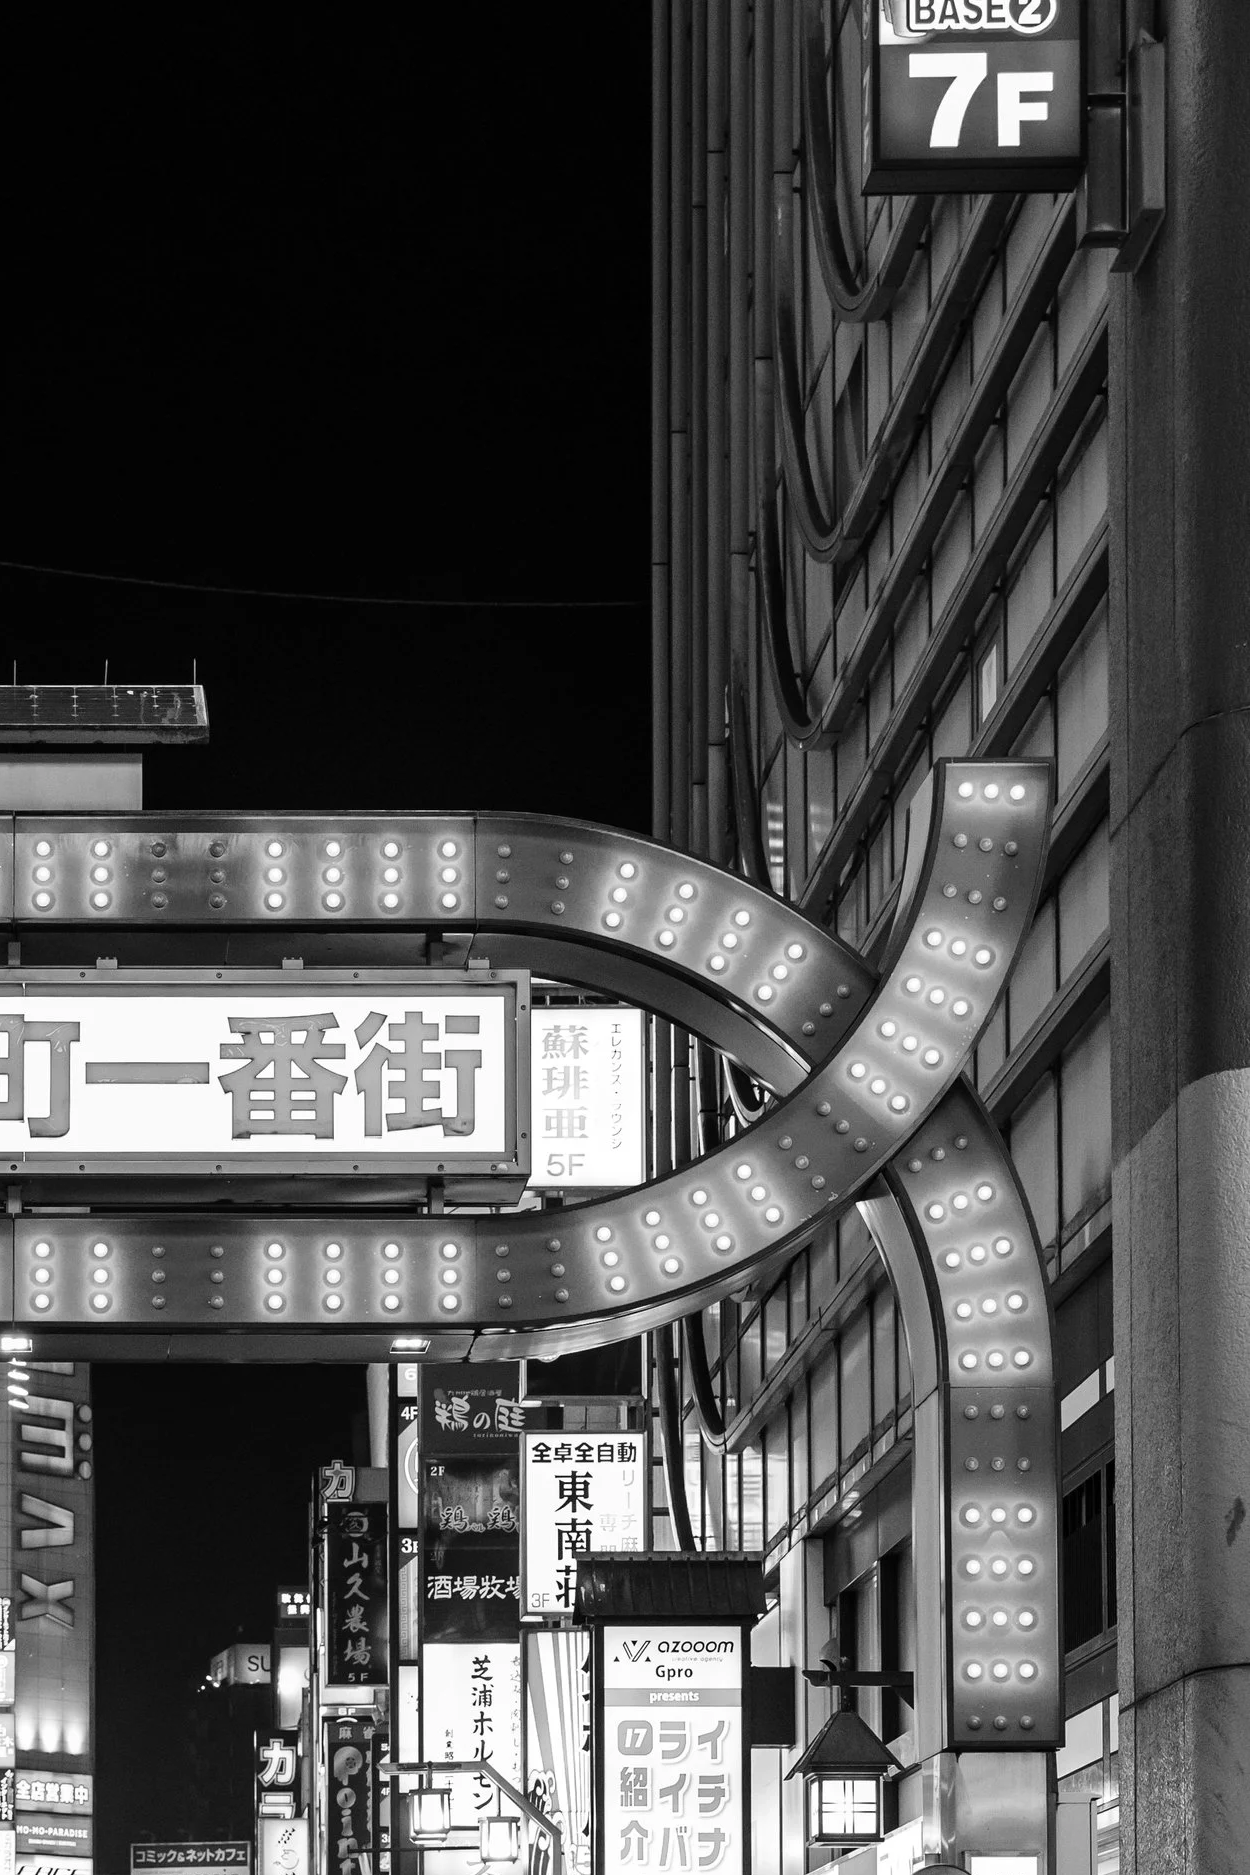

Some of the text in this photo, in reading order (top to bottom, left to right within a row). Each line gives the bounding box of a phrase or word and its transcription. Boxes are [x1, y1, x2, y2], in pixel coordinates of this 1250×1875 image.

[908, 52, 1054, 149] 7F
[546, 1153, 586, 1177] 5F
[531, 1441, 638, 1464] 全卓全自動
[531, 1592, 550, 1609] 3F
[657, 1640, 735, 1653] azooom
[655, 1664, 694, 1681] Gpro
[649, 1691, 700, 1704] presents
[135, 1848, 247, 1863] コミック&ネットカフェ
